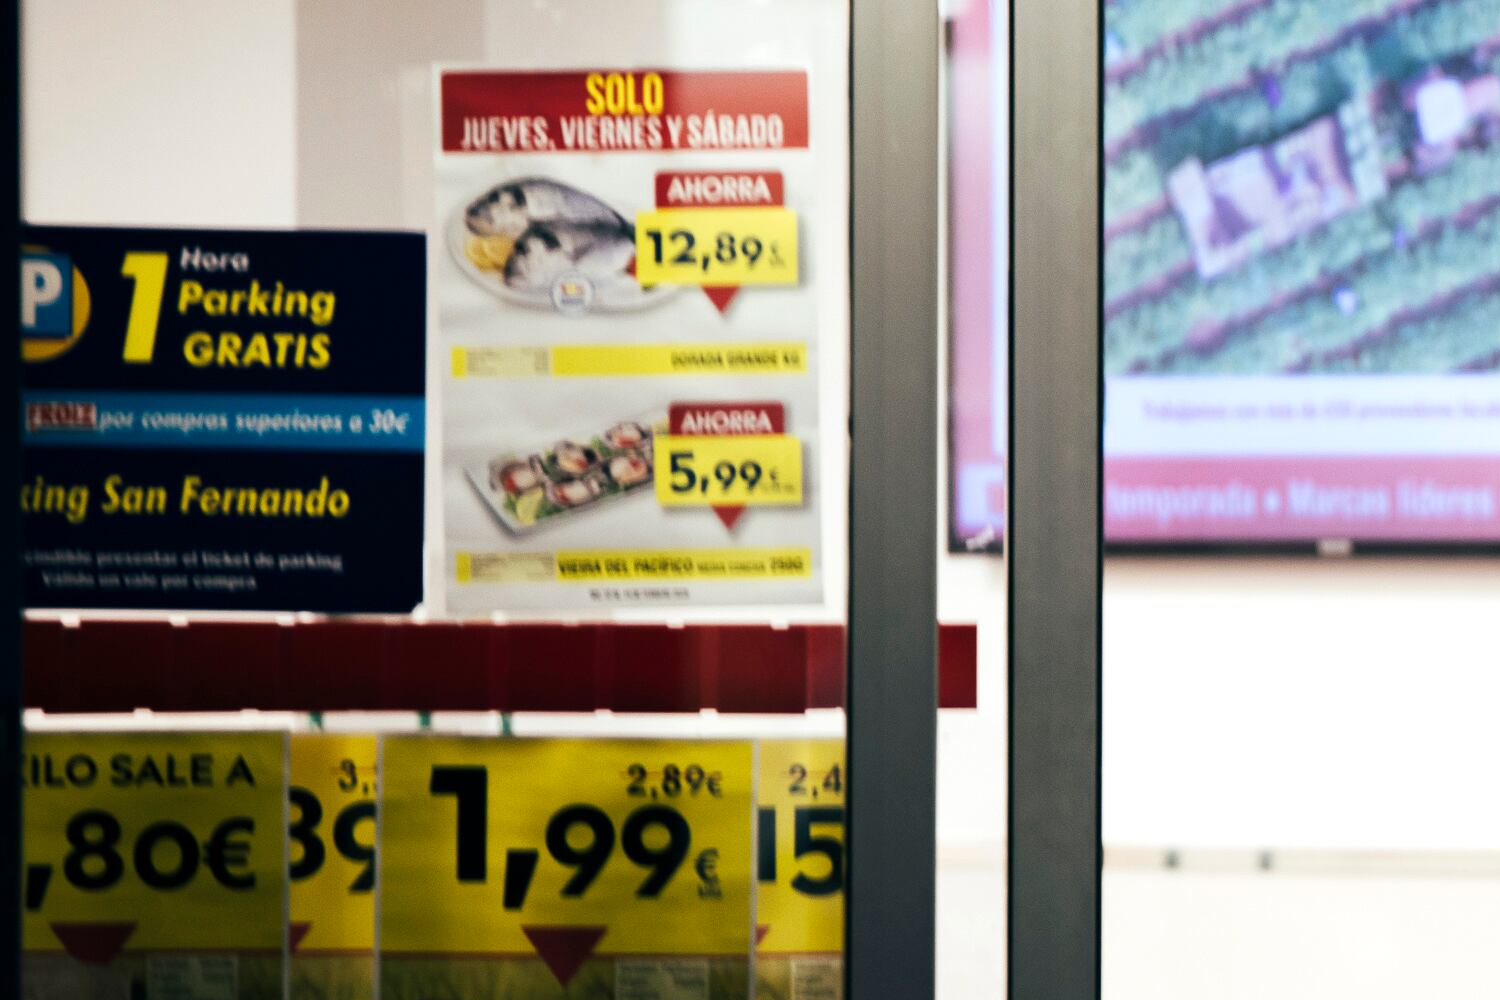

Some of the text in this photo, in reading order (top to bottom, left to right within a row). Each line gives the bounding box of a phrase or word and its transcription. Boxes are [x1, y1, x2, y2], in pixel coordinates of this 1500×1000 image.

[586, 72, 665, 115] SOLO
[461, 109, 785, 153] JUEVES, VIERNES Y SÁBADO
[666, 176, 773, 204] AHORRA
[646, 230, 764, 273] 12,89
[21, 258, 63, 328] P
[120, 251, 169, 364] 1
[177, 280, 336, 326] Parking
[183, 332, 332, 369] GRATIS
[142, 411, 228, 437] compras
[236, 407, 342, 437] superiores
[680, 410, 774, 435] AHORRA
[102, 474, 168, 515] San
[180, 475, 351, 517] Fernando
[669, 451, 763, 498] 5,99
[1288, 478, 1391, 519] Marcas
[22, 753, 257, 788] ILO SALE A
[337, 758, 378, 795] 3,
[626, 763, 723, 800] 2,89€
